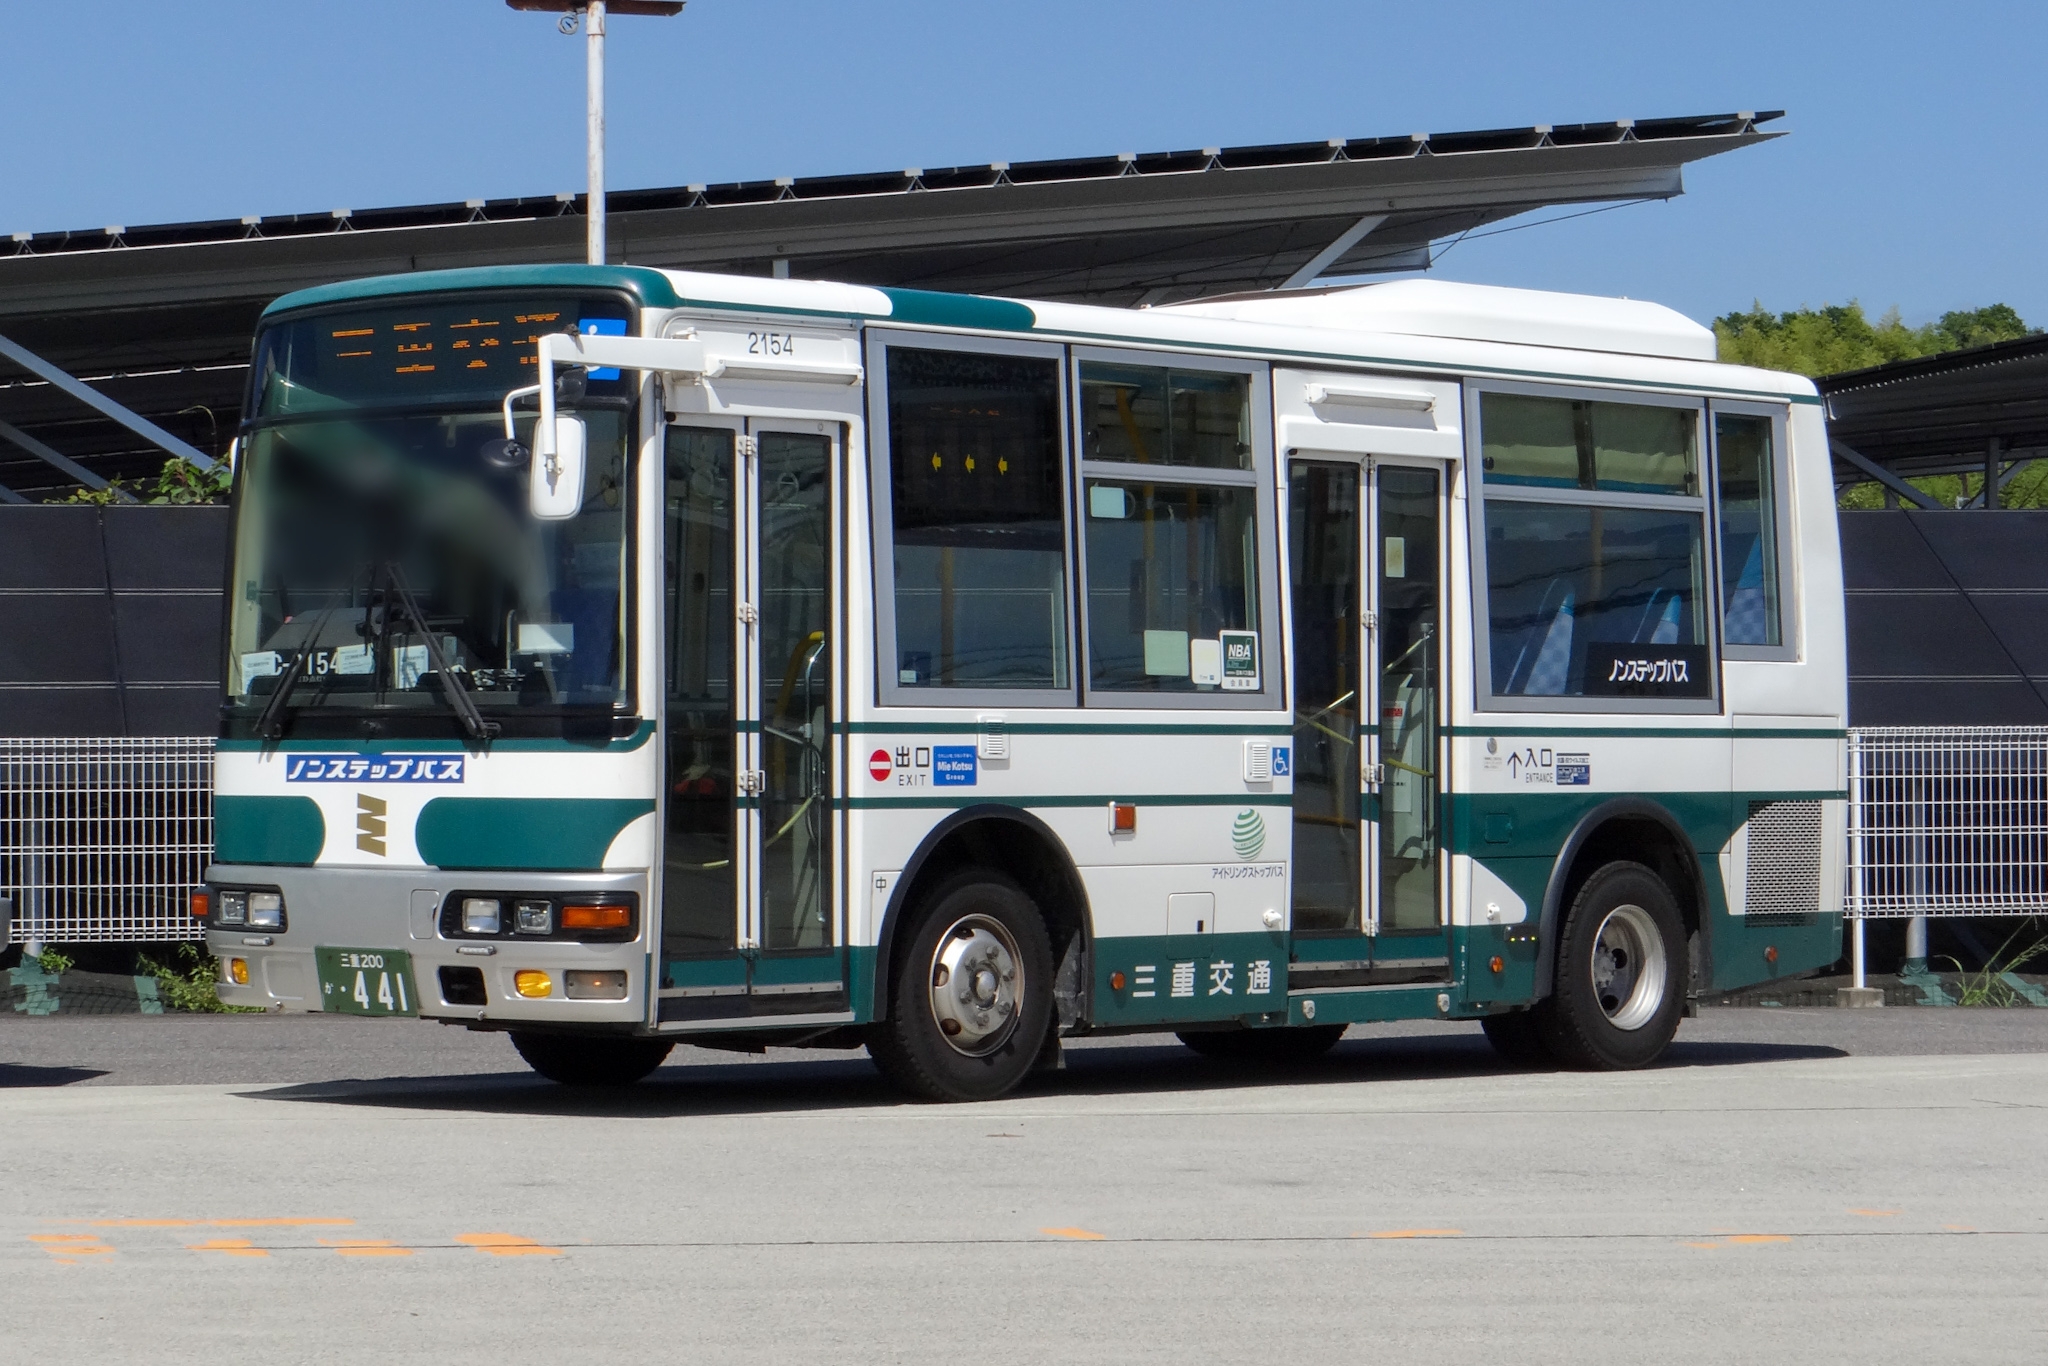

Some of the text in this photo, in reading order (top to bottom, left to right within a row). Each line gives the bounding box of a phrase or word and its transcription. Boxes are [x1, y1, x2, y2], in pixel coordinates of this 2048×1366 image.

[748, 331, 793, 356] 2154
[1228, 644, 1251, 658] NBA
[1608, 658, 1689, 682] ノンステップバス
[895, 745, 930, 768] 出口
[1525, 748, 1552, 767] 入口
[288, 758, 463, 781] ノンステップバス
[937, 761, 974, 771] Mie Kotsu
[898, 774, 927, 786] EXIT
[945, 773, 966, 781] Group
[1525, 772, 1554, 783] ENTRANCE
[1212, 866, 1284, 879] アイドリングストップバス
[876, 876, 886, 893] 中
[340, 953, 384, 969] 三重200
[1132, 959, 1271, 998] 三重交通
